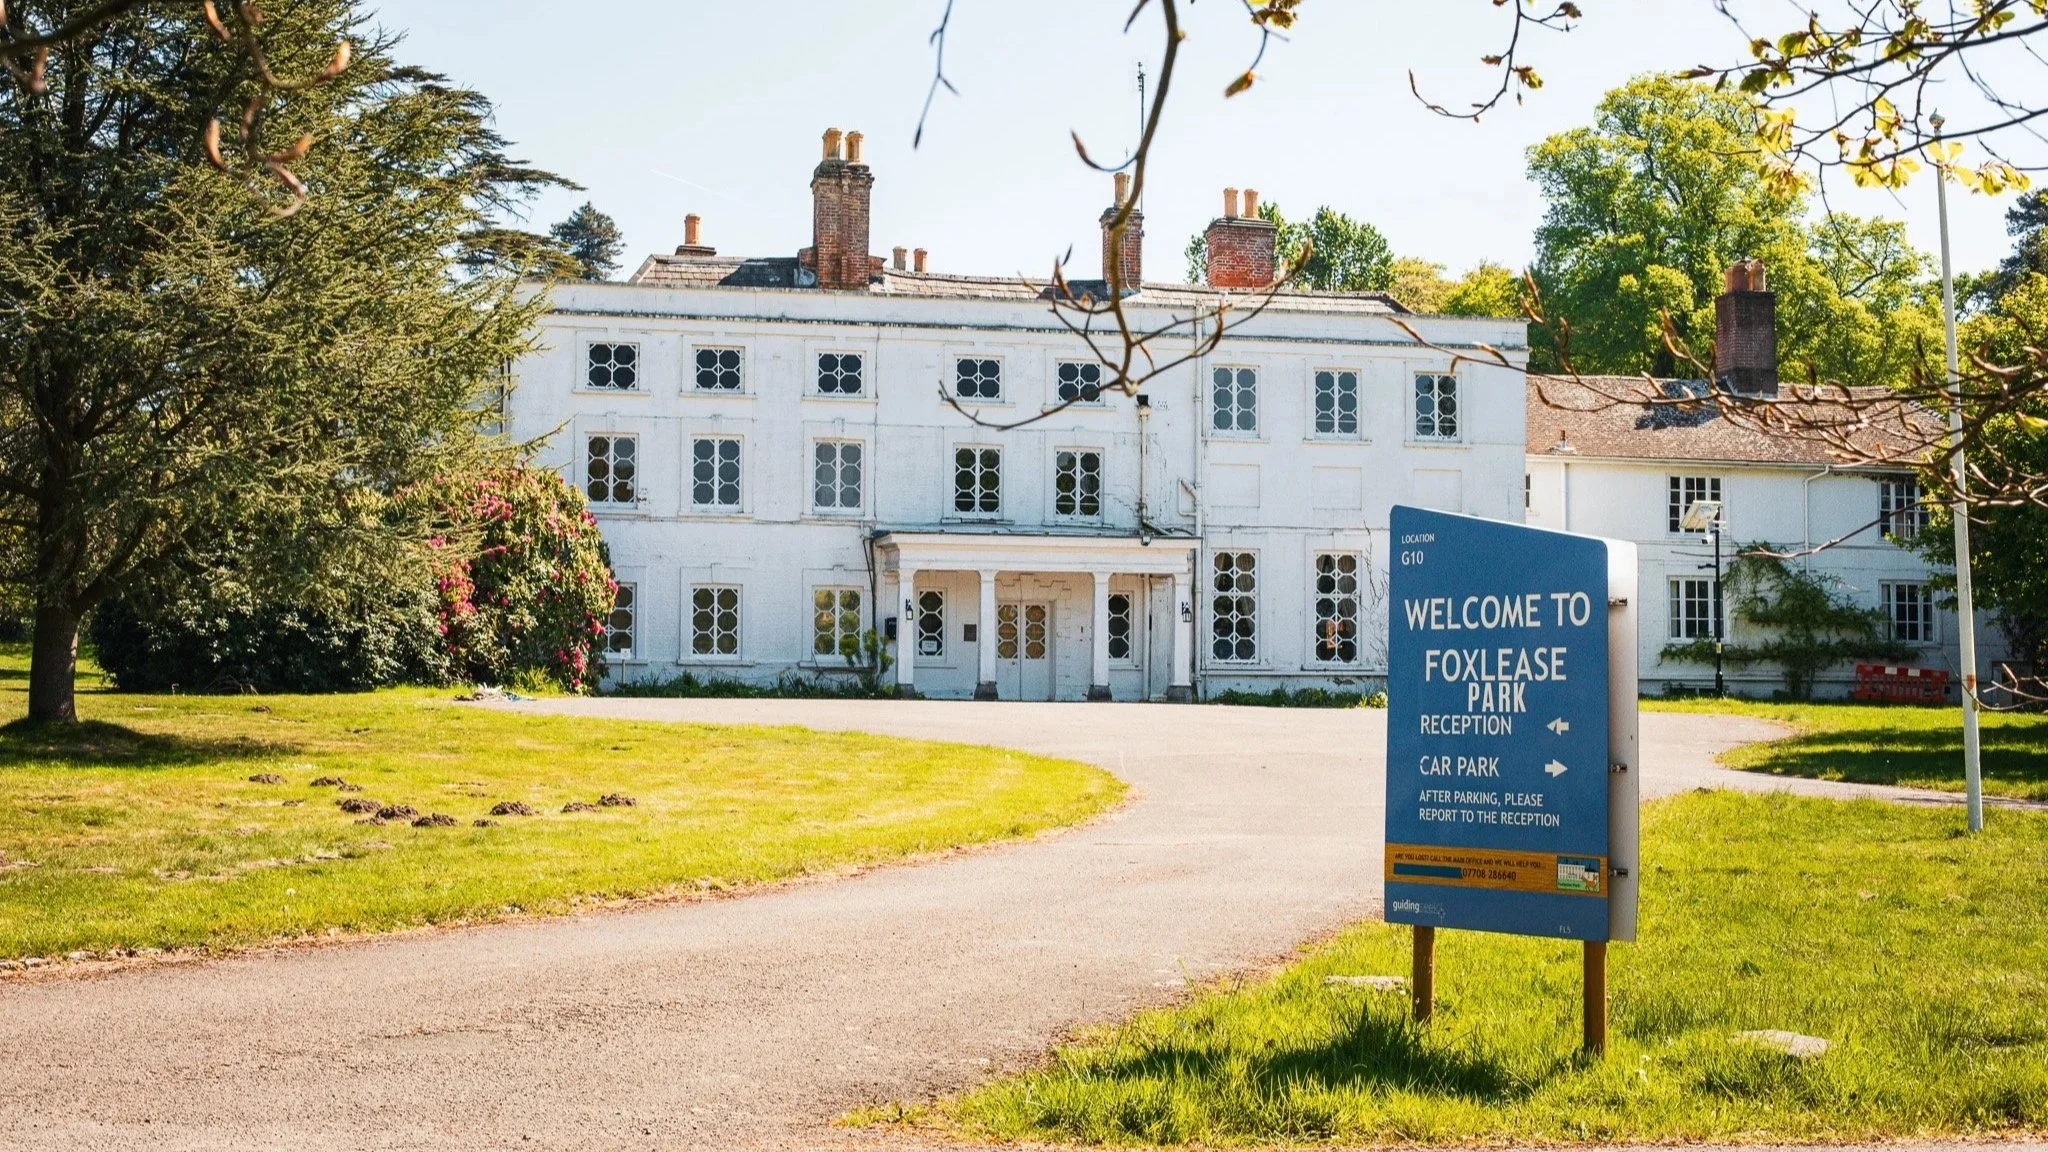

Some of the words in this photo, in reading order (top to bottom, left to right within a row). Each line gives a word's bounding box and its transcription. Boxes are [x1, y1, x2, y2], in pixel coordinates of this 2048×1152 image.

[1401, 533, 1435, 544] LOCATION
[1401, 551, 1424, 565] G10
[1404, 594, 1541, 631] WELCOME
[1550, 592, 1590, 627] TO
[1425, 647, 1567, 682] FOXLEASE
[1467, 682, 1527, 713] PARK
[1420, 714, 1512, 735] RECEPTION
[1420, 755, 1451, 776] CAR
[1457, 756, 1500, 777] PARK
[1419, 790, 1451, 803] AFTER
[1454, 791, 1501, 807] PARKING,
[1504, 793, 1543, 807] PLEASE
[1419, 808, 1457, 822] REPORT
[1460, 809, 1474, 823] TO
[1476, 810, 1497, 824] THE
[1500, 812, 1560, 827] RECEPTION
[1465, 857, 1482, 865] OFFICE
[1483, 858, 1494, 866] AND
[1516, 860, 1529, 868] HELP
[1462, 868, 1486, 879] 07708
[1489, 869, 1517, 881] 286640
[1393, 899, 1420, 913] guiding
